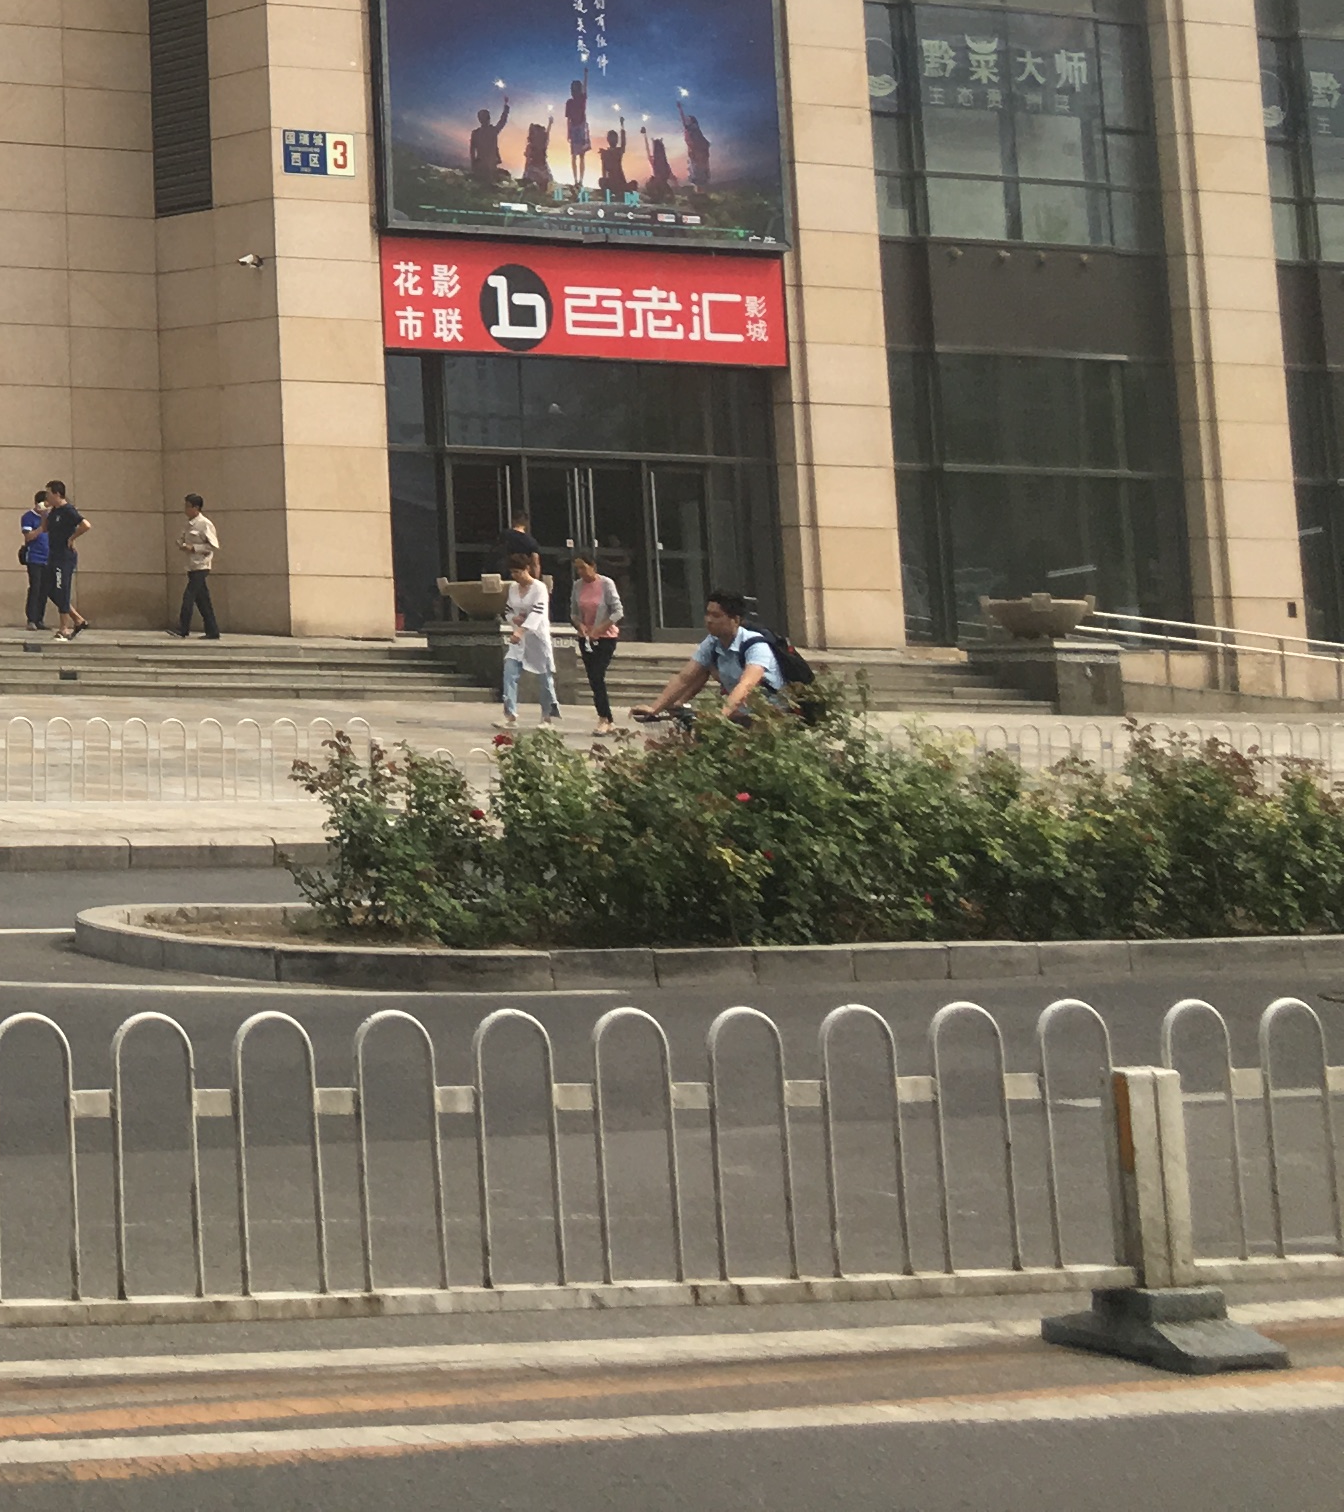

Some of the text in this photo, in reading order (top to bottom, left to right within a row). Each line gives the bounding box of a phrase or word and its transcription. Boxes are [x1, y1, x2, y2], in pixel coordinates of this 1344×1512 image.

[291, 152, 320, 168] 西区
[332, 140, 348, 170] 3
[563, 285, 745, 343] 百老汇
[745, 294, 770, 343] 影城
